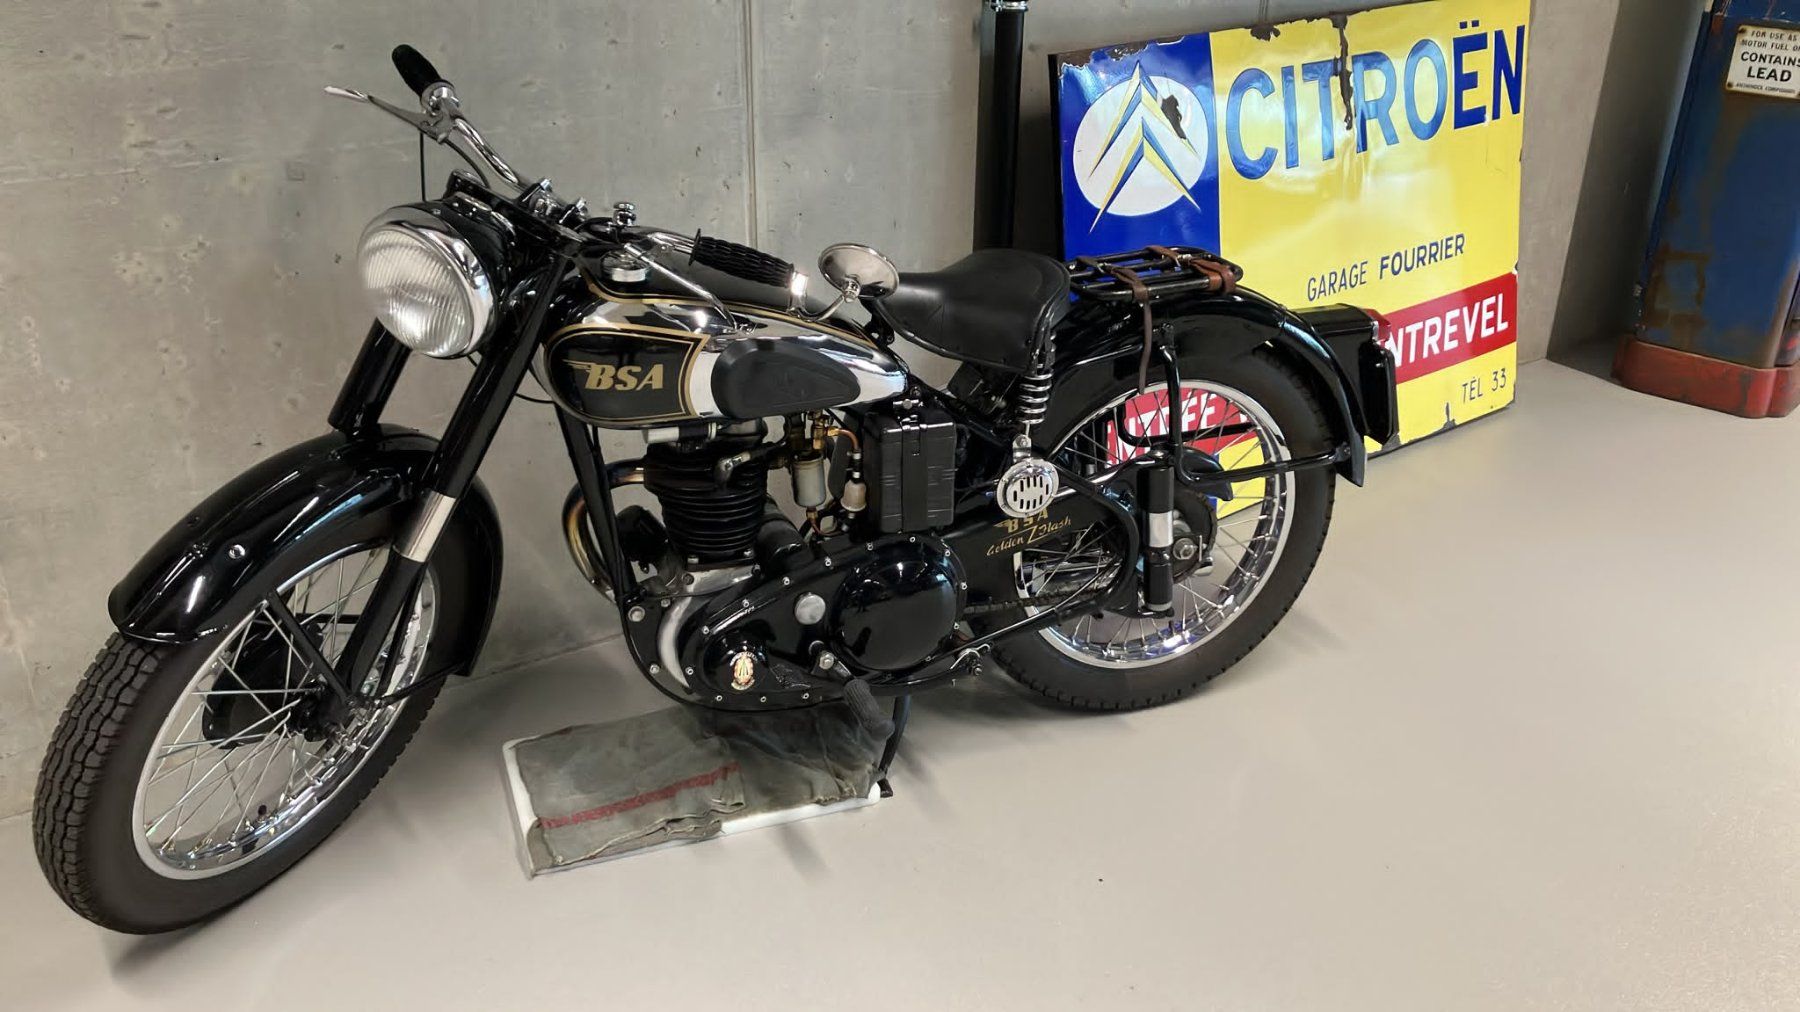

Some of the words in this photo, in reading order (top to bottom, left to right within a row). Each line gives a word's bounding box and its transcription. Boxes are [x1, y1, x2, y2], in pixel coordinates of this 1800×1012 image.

[1742, 39, 1767, 48] MOTOR
[1771, 43, 1788, 51] FUEL
[1770, 32, 1784, 40] USE
[1747, 66, 1792, 82] LEAD
[1226, 20, 1525, 180] CITROËN
[1307, 261, 1368, 301] GARAGE
[1379, 233, 1465, 280] FOURRIER
[1384, 293, 1508, 368] NTREVEL
[584, 363, 664, 391] BSA
[1491, 368, 1507, 392] 33
